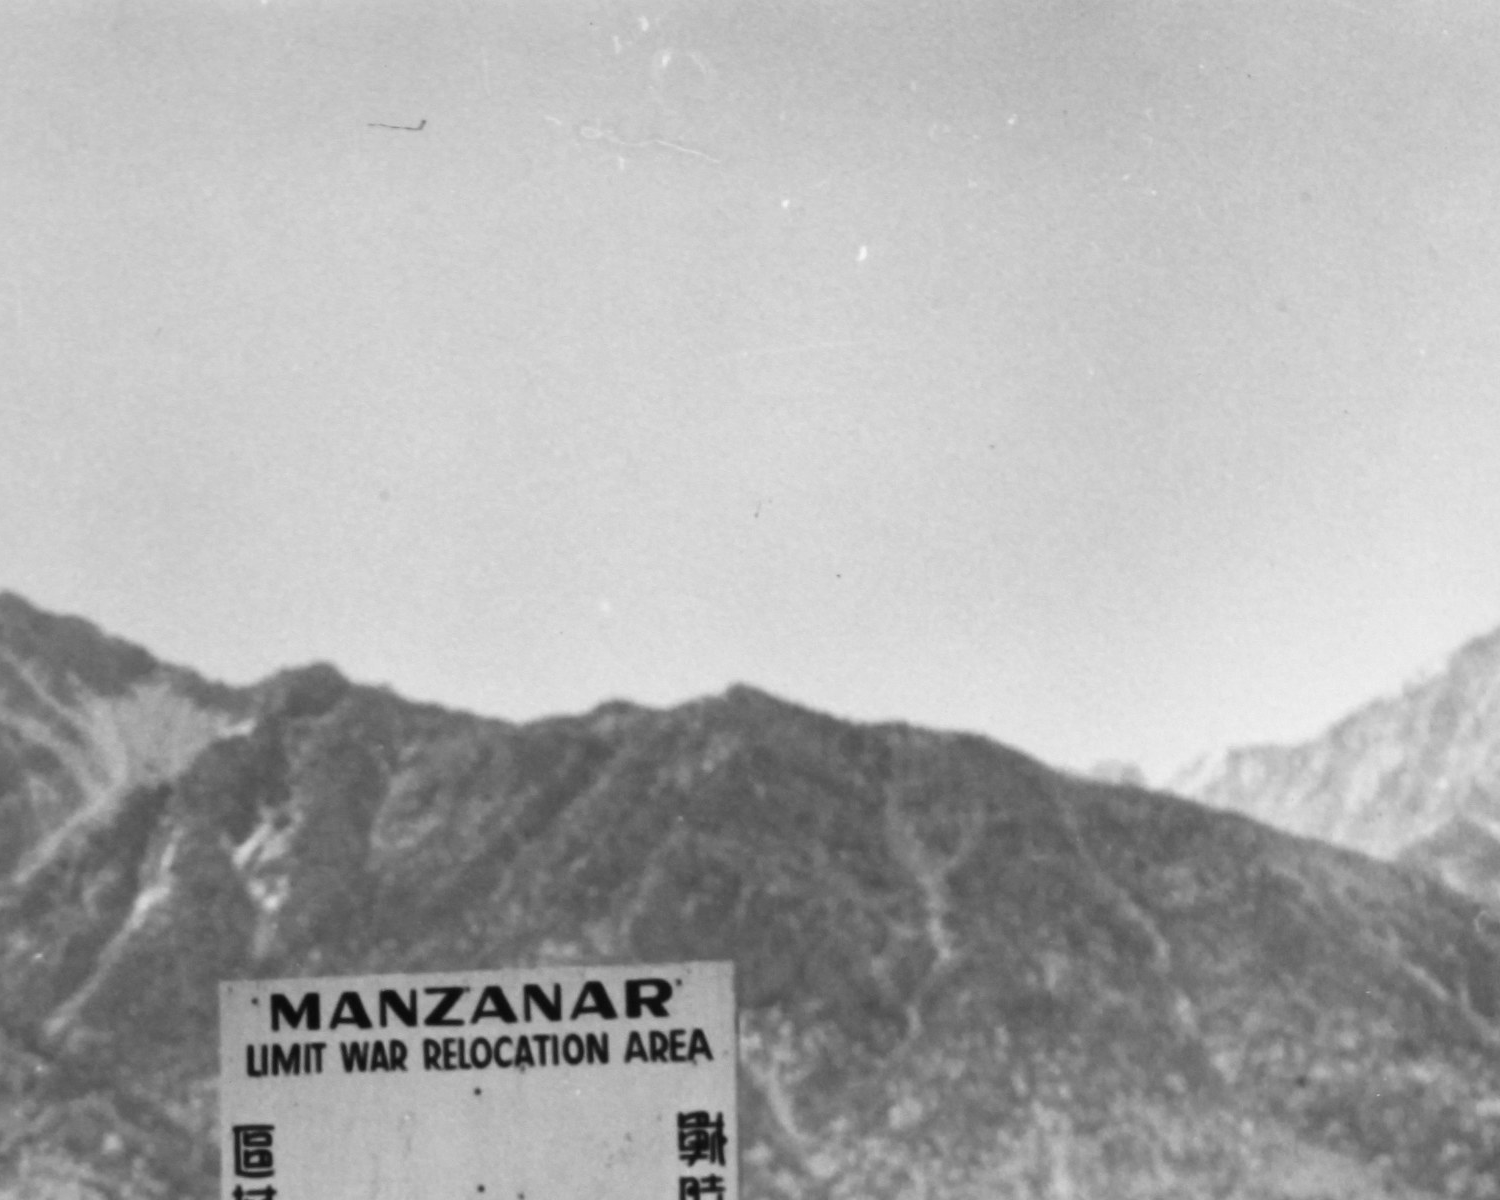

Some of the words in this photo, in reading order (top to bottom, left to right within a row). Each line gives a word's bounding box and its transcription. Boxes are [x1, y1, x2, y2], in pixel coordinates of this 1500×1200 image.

[268, 977, 674, 1033] MANZANAR
[246, 1042, 328, 1078] LIMIT
[339, 1039, 409, 1073] WAR
[422, 1032, 611, 1071] RELOCATION
[623, 1028, 715, 1063] AREA
